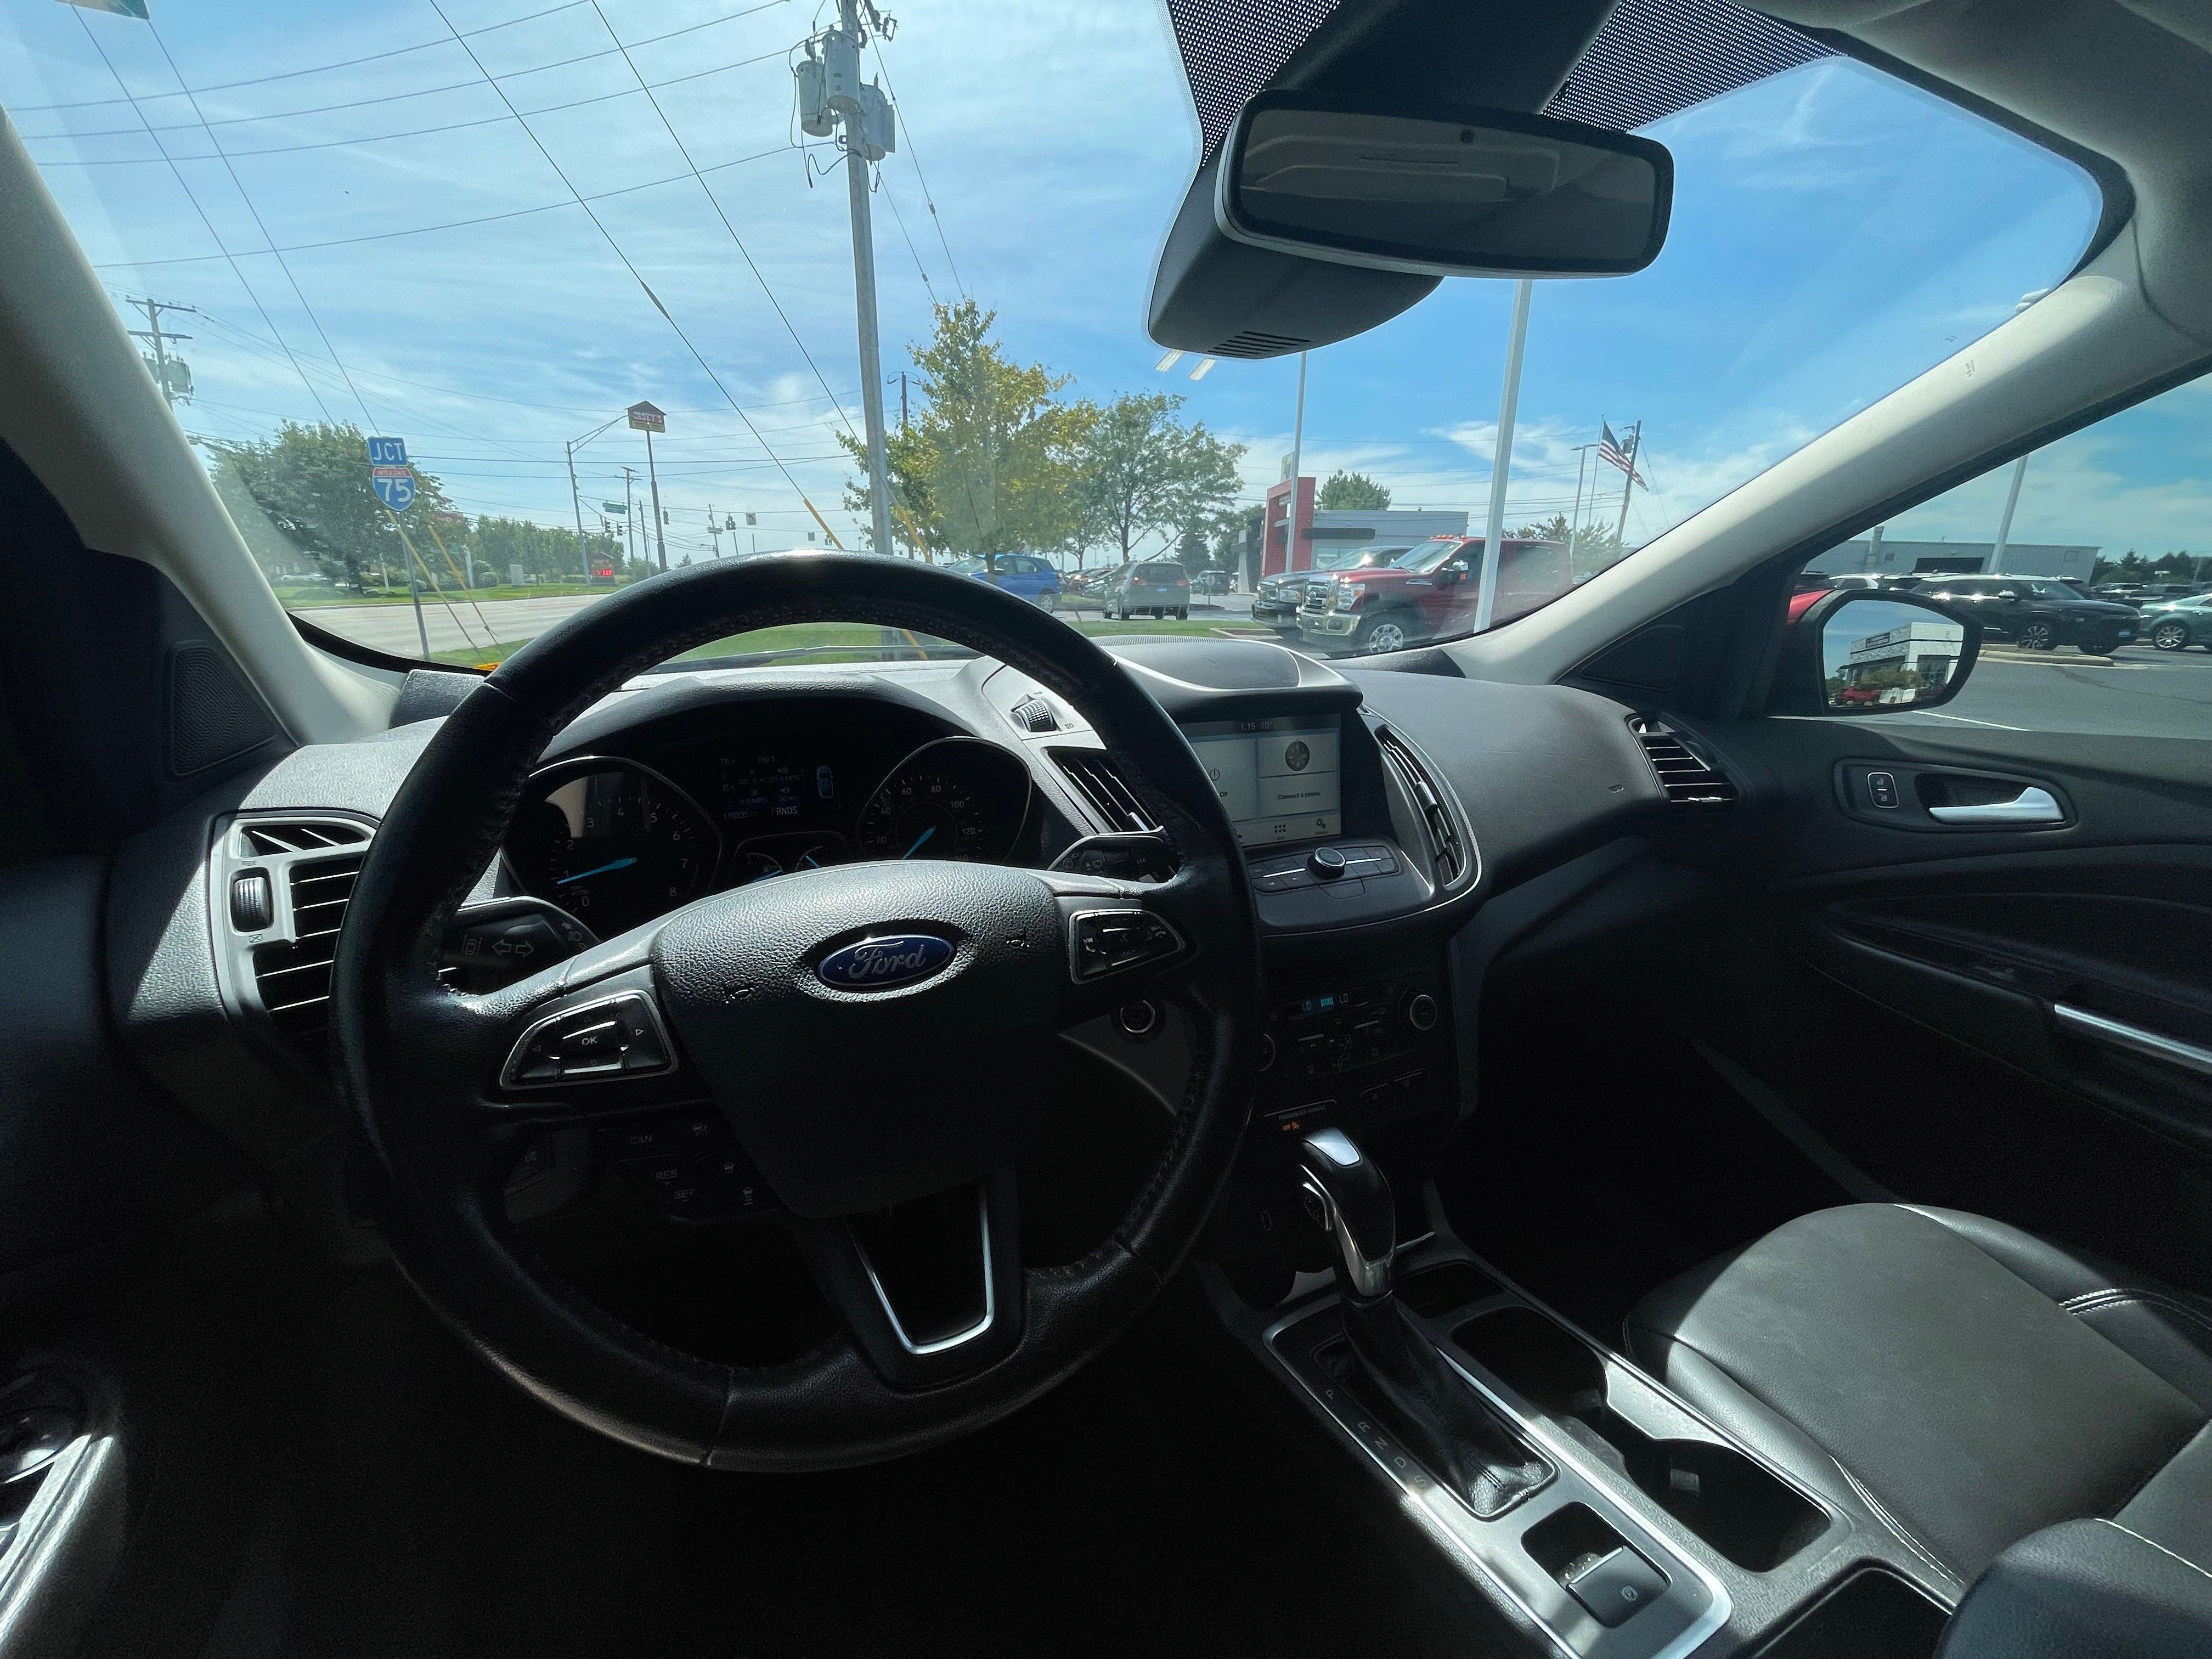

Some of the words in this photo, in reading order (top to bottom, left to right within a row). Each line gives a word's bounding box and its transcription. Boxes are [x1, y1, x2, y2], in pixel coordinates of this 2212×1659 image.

[633, 411, 663, 423] CASEY'S
[373, 442, 403, 461] JCT
[377, 478, 411, 503] 75
[901, 787, 912, 795] 60
[931, 785, 941, 793] 80
[1278, 792, 1300, 800] Connect
[617, 808, 625, 817] 4
[650, 812, 658, 823] 5
[586, 818, 594, 828] 3
[673, 831, 680, 840] 6
[567, 840, 575, 850] 2
[680, 859, 688, 868] 7
[669, 887, 677, 896] 8
[581, 896, 590, 907] 0
[849, 940, 927, 979] Ford
[581, 1036, 598, 1046] OK
[630, 1134, 653, 1145] CAN
[655, 1169, 678, 1181] RES
[674, 1188, 695, 1203] SET
[1325, 1389, 1334, 1400] P
[1358, 1421, 1370, 1432] R
[1374, 1436, 1388, 1450] N
[1393, 1456, 1407, 1469] D
[1414, 1475, 1427, 1487] S
